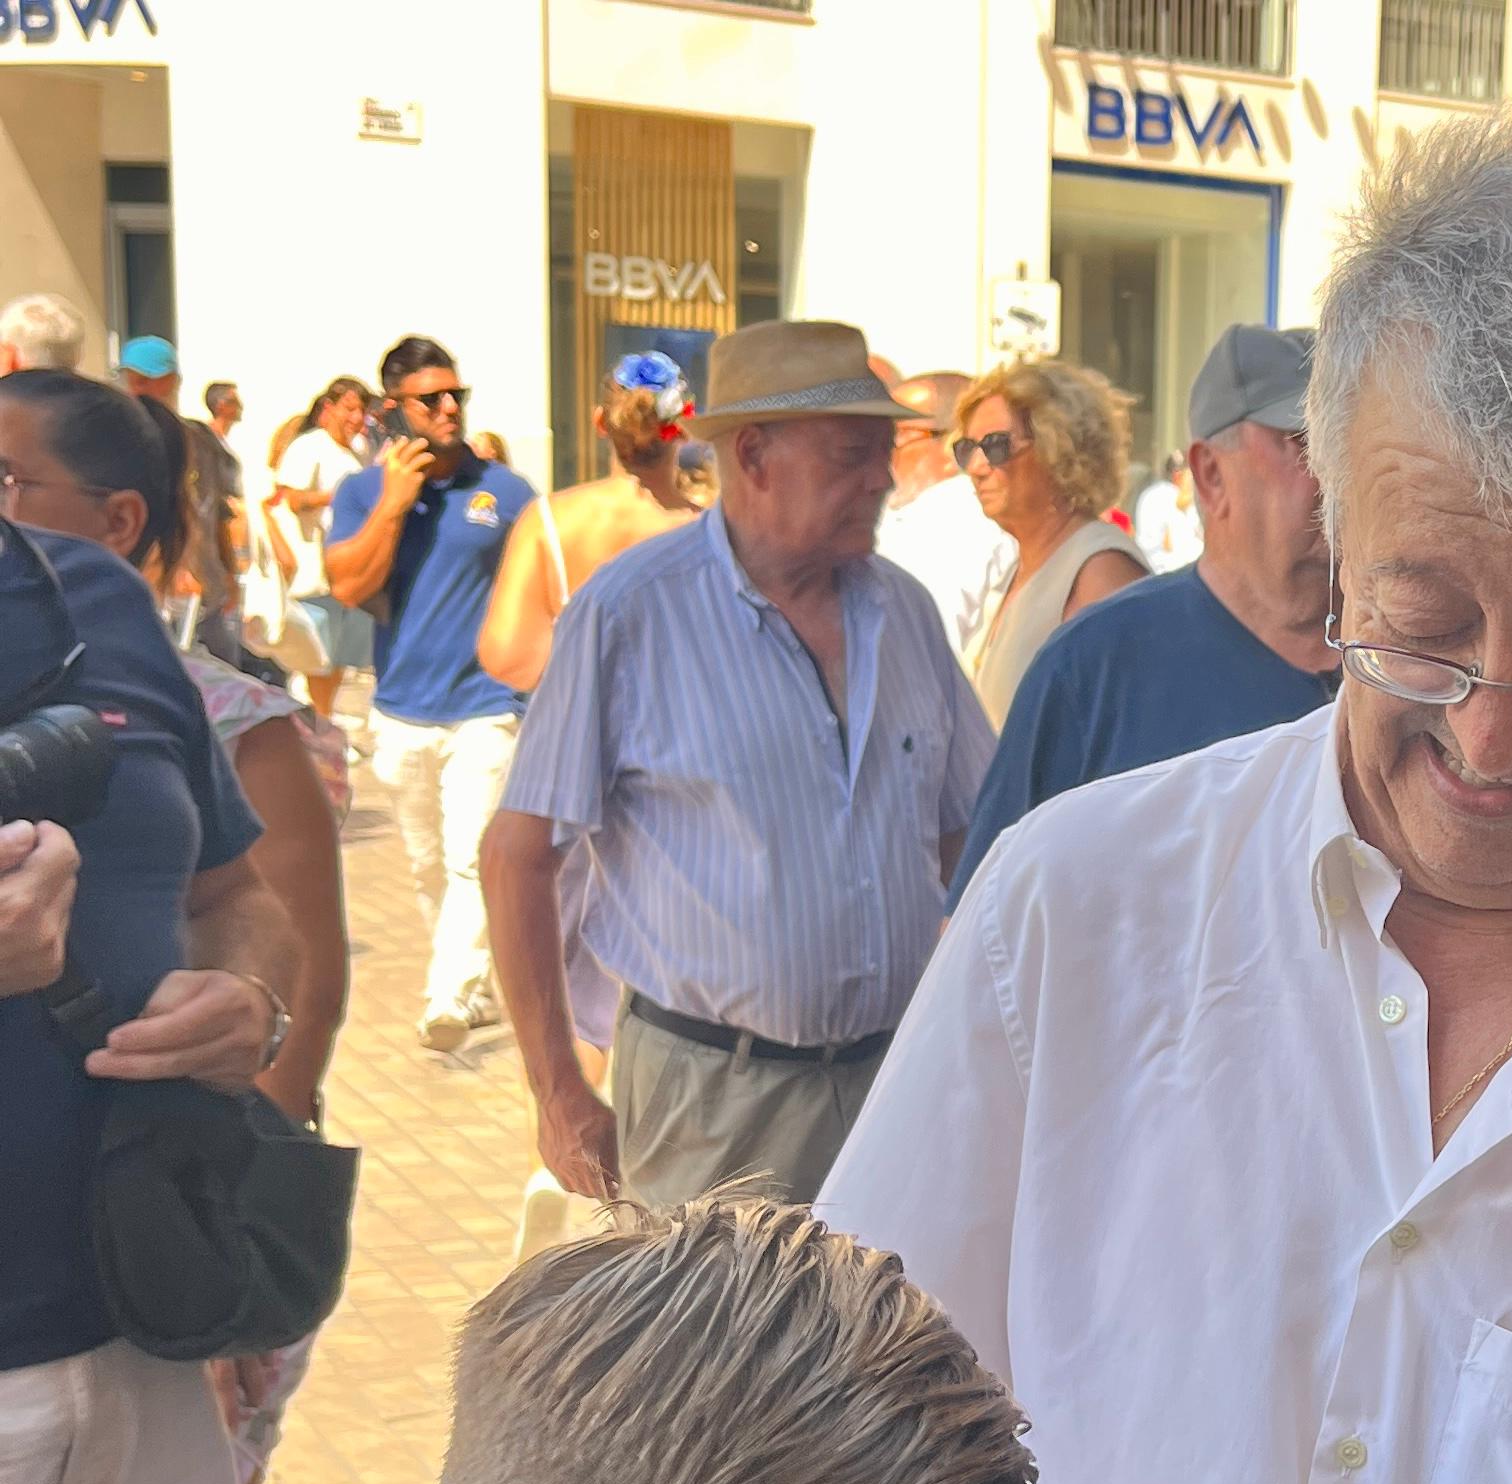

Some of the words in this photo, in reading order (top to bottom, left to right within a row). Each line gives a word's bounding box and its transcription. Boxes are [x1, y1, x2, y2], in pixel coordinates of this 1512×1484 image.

[0, 0, 157, 44] BVA
[1087, 80, 1262, 151] BBVA
[584, 252, 727, 304] BBVA
